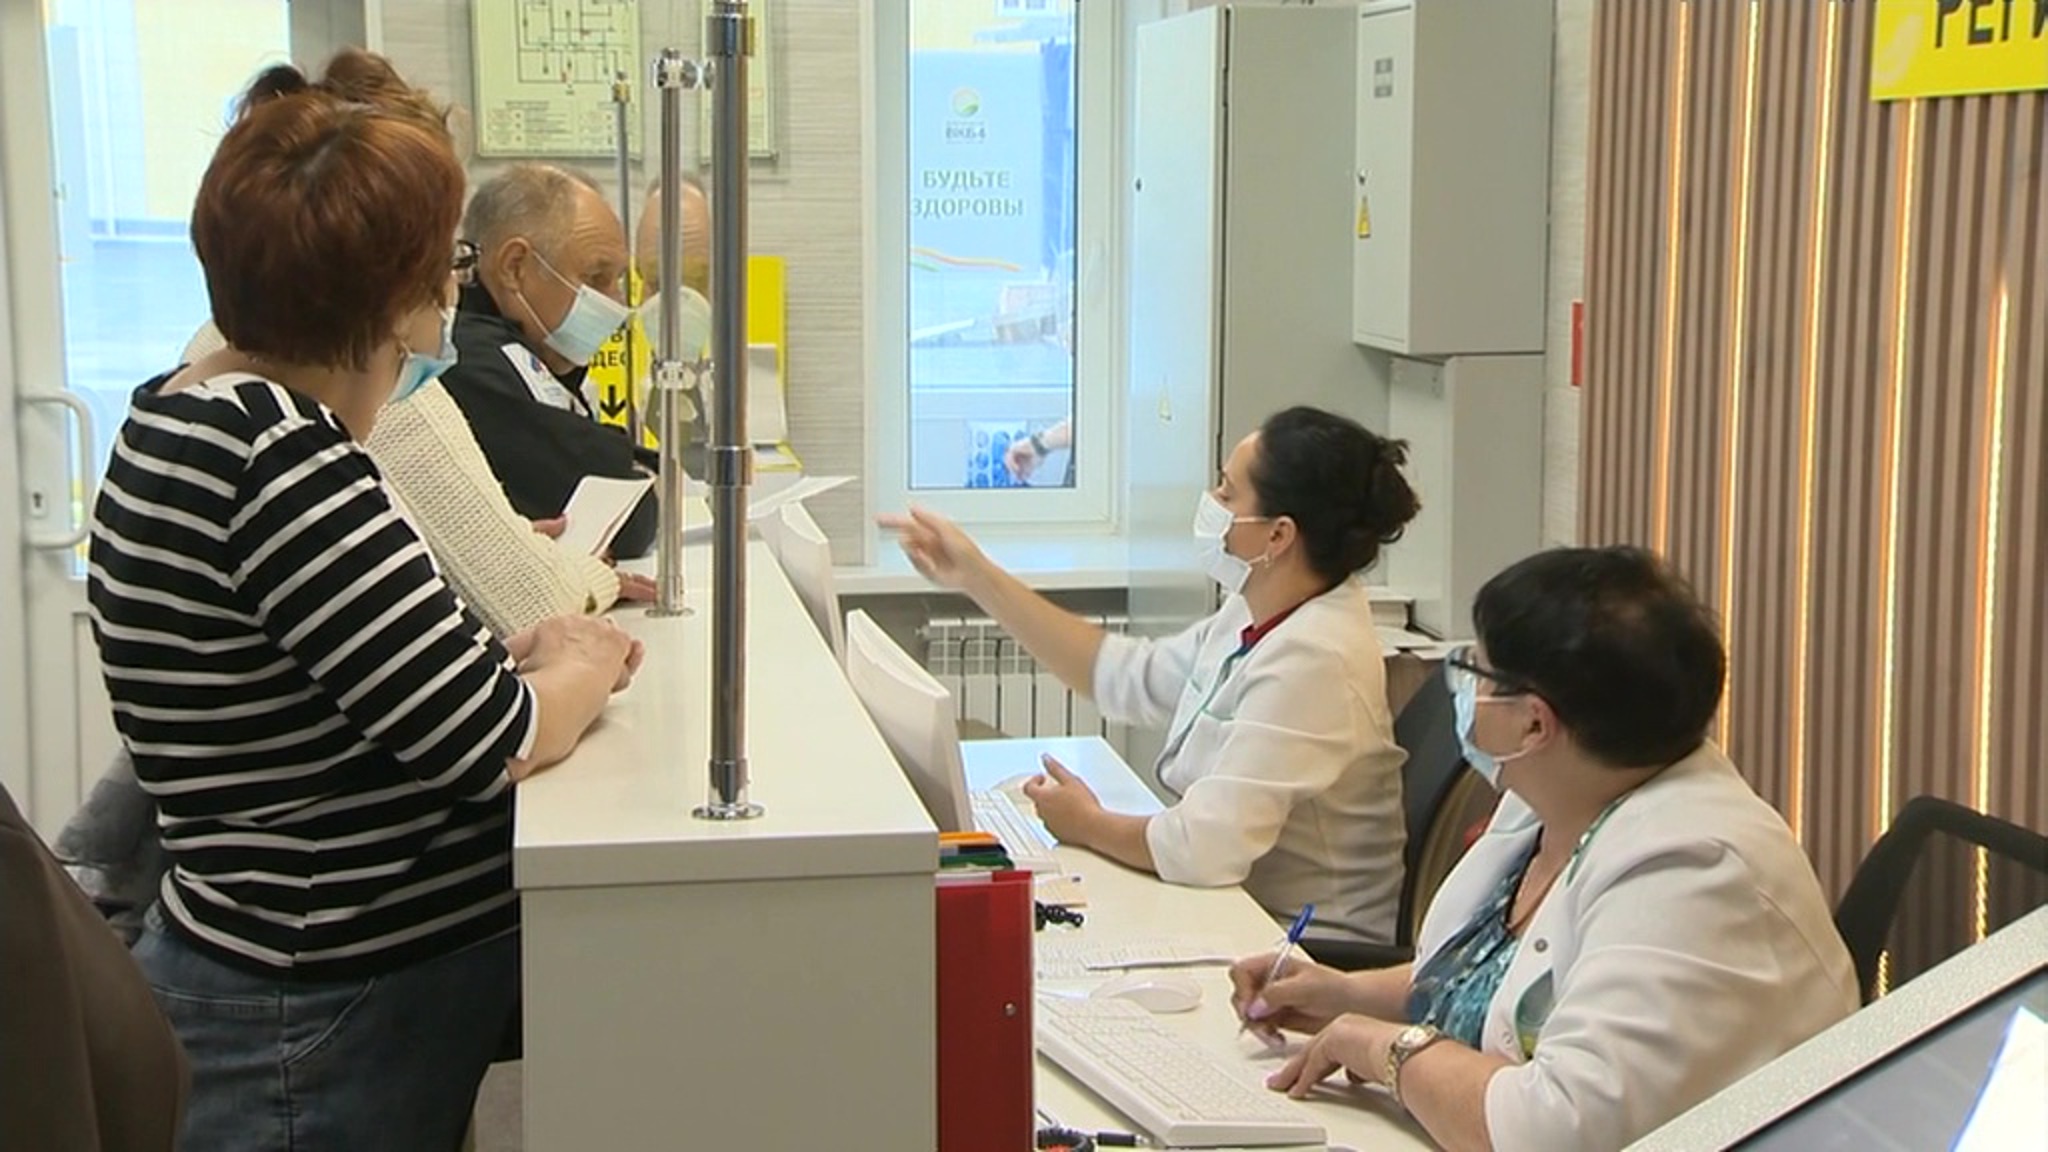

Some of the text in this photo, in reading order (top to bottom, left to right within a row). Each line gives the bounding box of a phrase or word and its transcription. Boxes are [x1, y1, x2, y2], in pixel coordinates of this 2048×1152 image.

[923, 170, 1010, 192] БУДЬТЕ
[912, 197, 1024, 219] ЗДОРОВЫ
[588, 350, 627, 368] ДЕС
